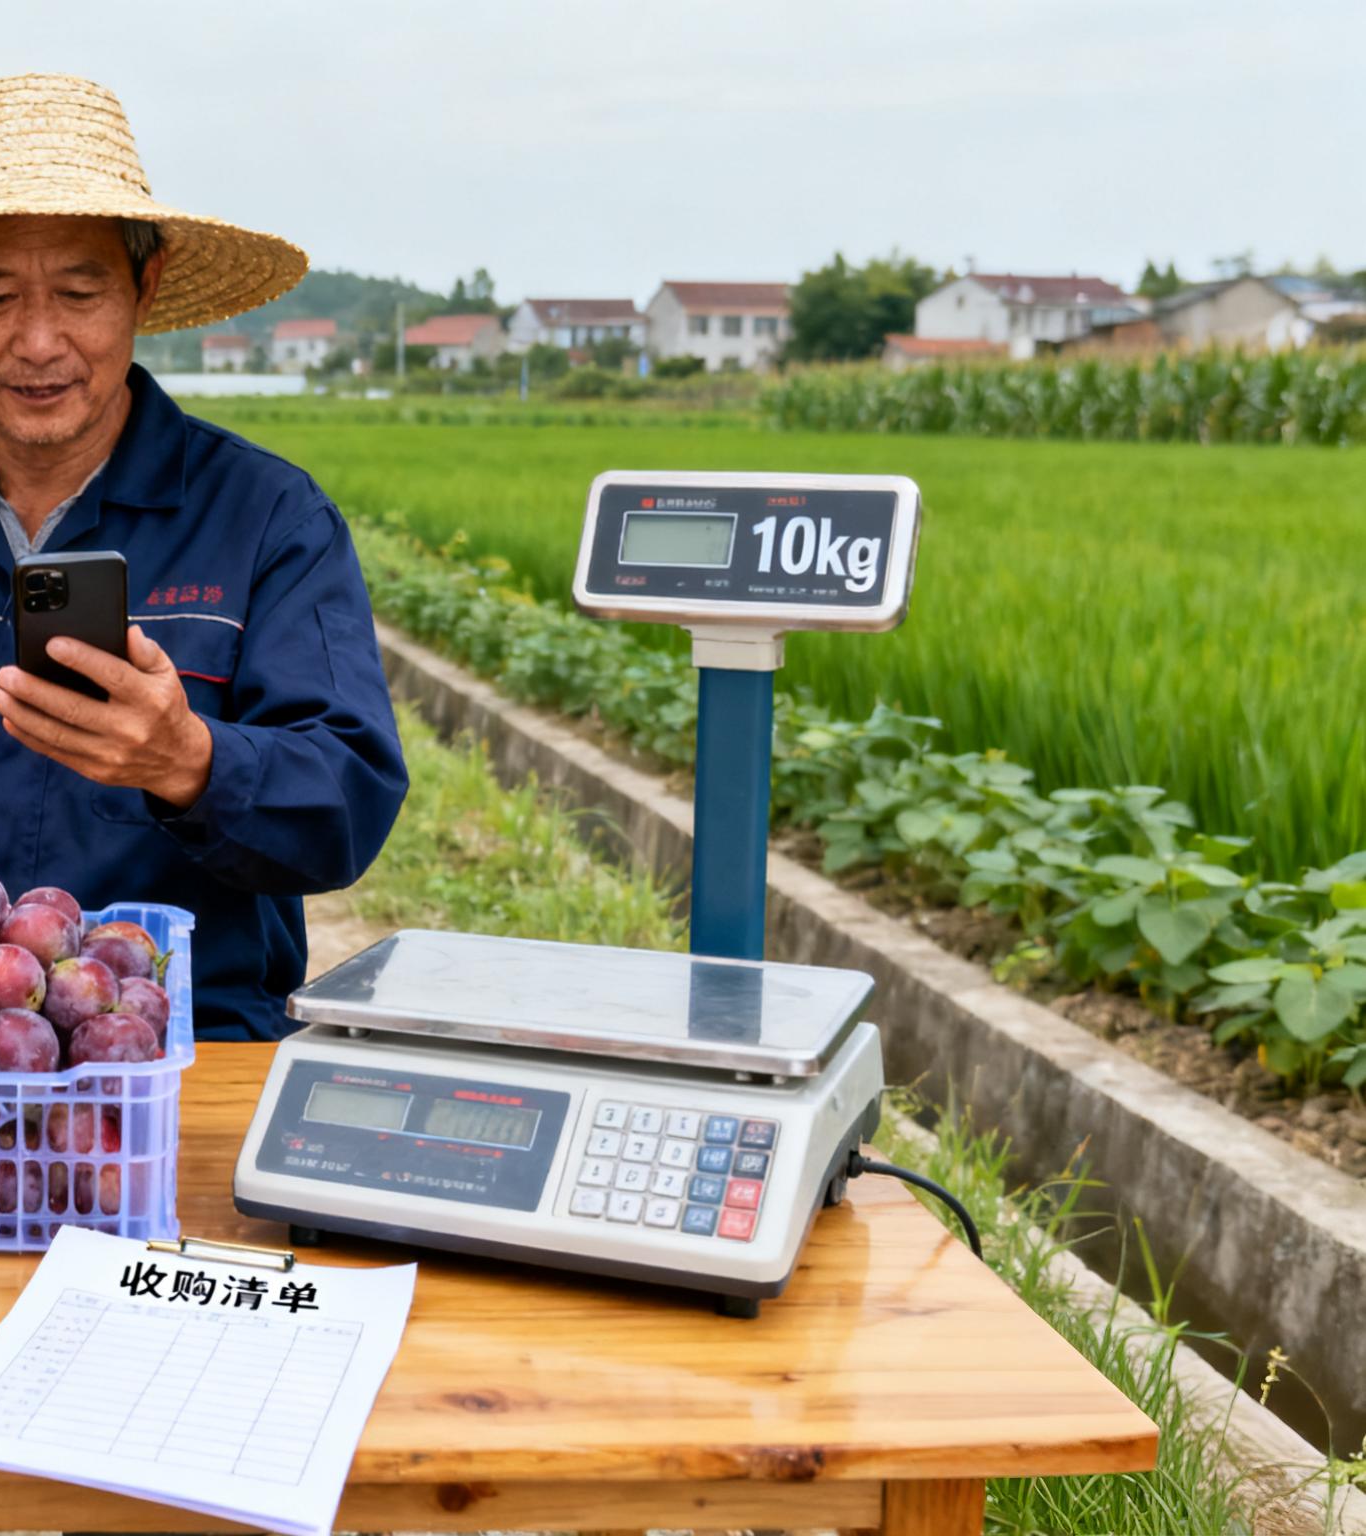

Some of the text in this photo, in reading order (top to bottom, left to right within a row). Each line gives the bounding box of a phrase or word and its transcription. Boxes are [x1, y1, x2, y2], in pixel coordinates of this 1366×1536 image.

[752, 515, 882, 592] 10kg
[120, 1261, 320, 1313] 收购清单
